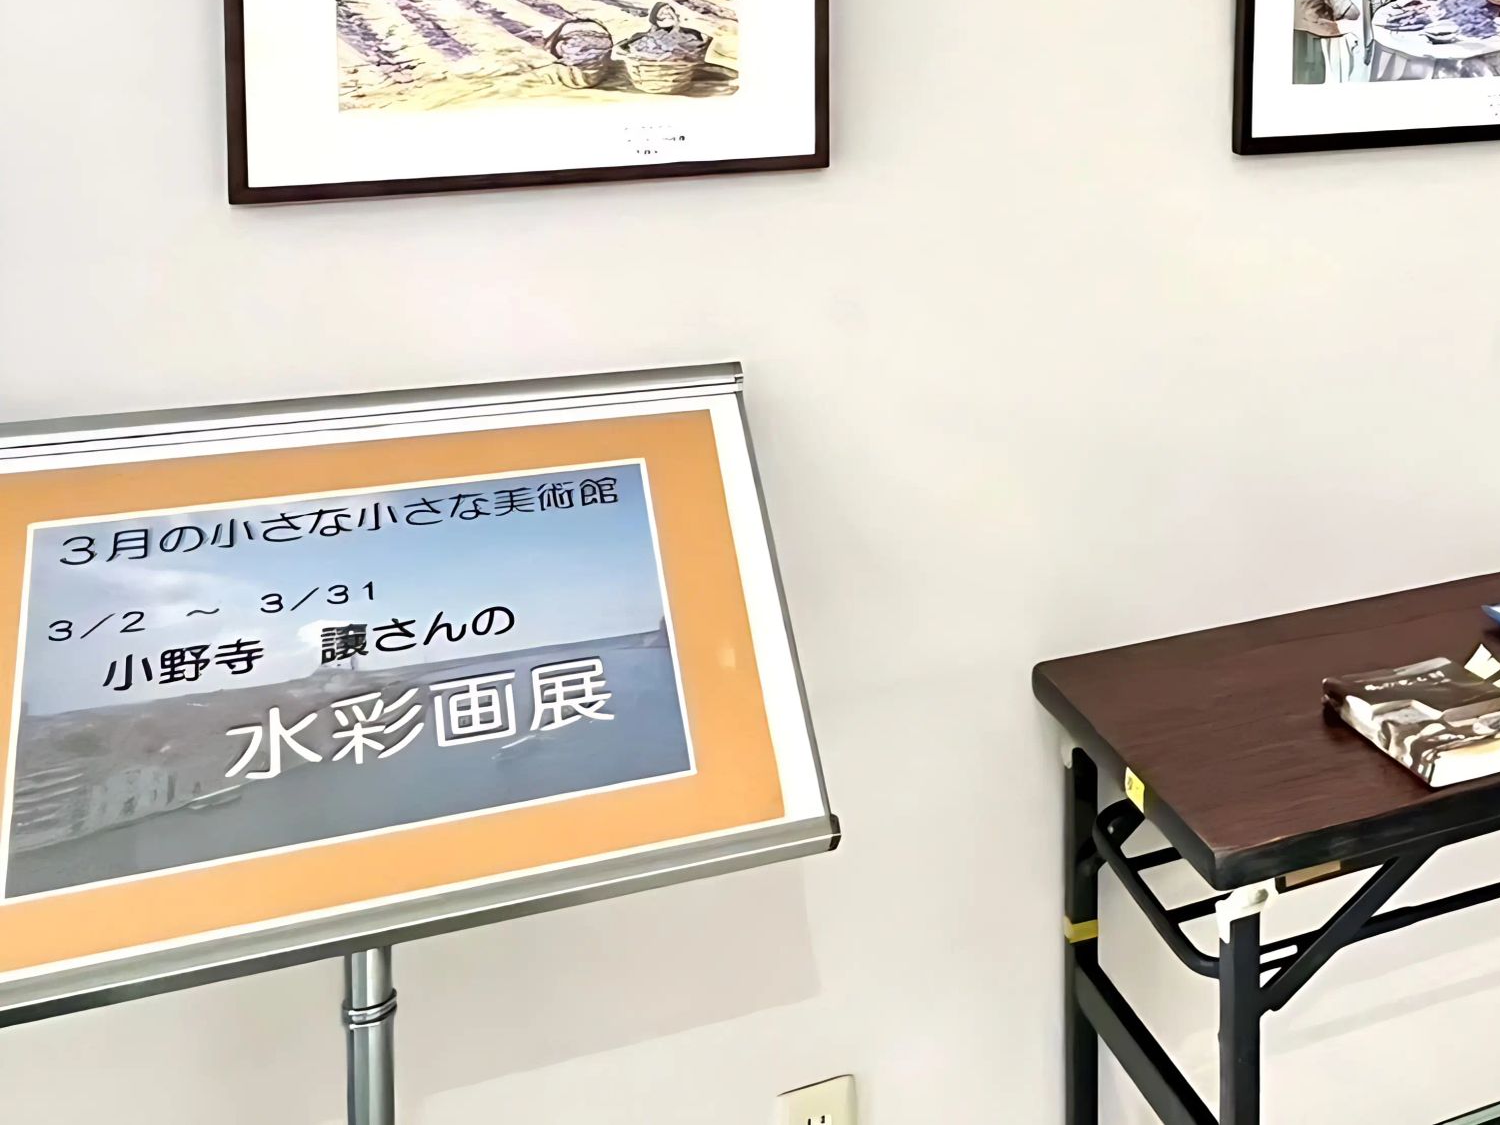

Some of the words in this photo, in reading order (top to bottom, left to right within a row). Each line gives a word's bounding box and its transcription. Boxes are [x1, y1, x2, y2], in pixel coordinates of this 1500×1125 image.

[59, 476, 619, 565] 3月の小さな小さな美術館
[48, 611, 146, 642] 3/2
[260, 581, 375, 614] 3/31
[102, 638, 265, 691] 小野寺
[225, 656, 616, 780] 水彩画展
